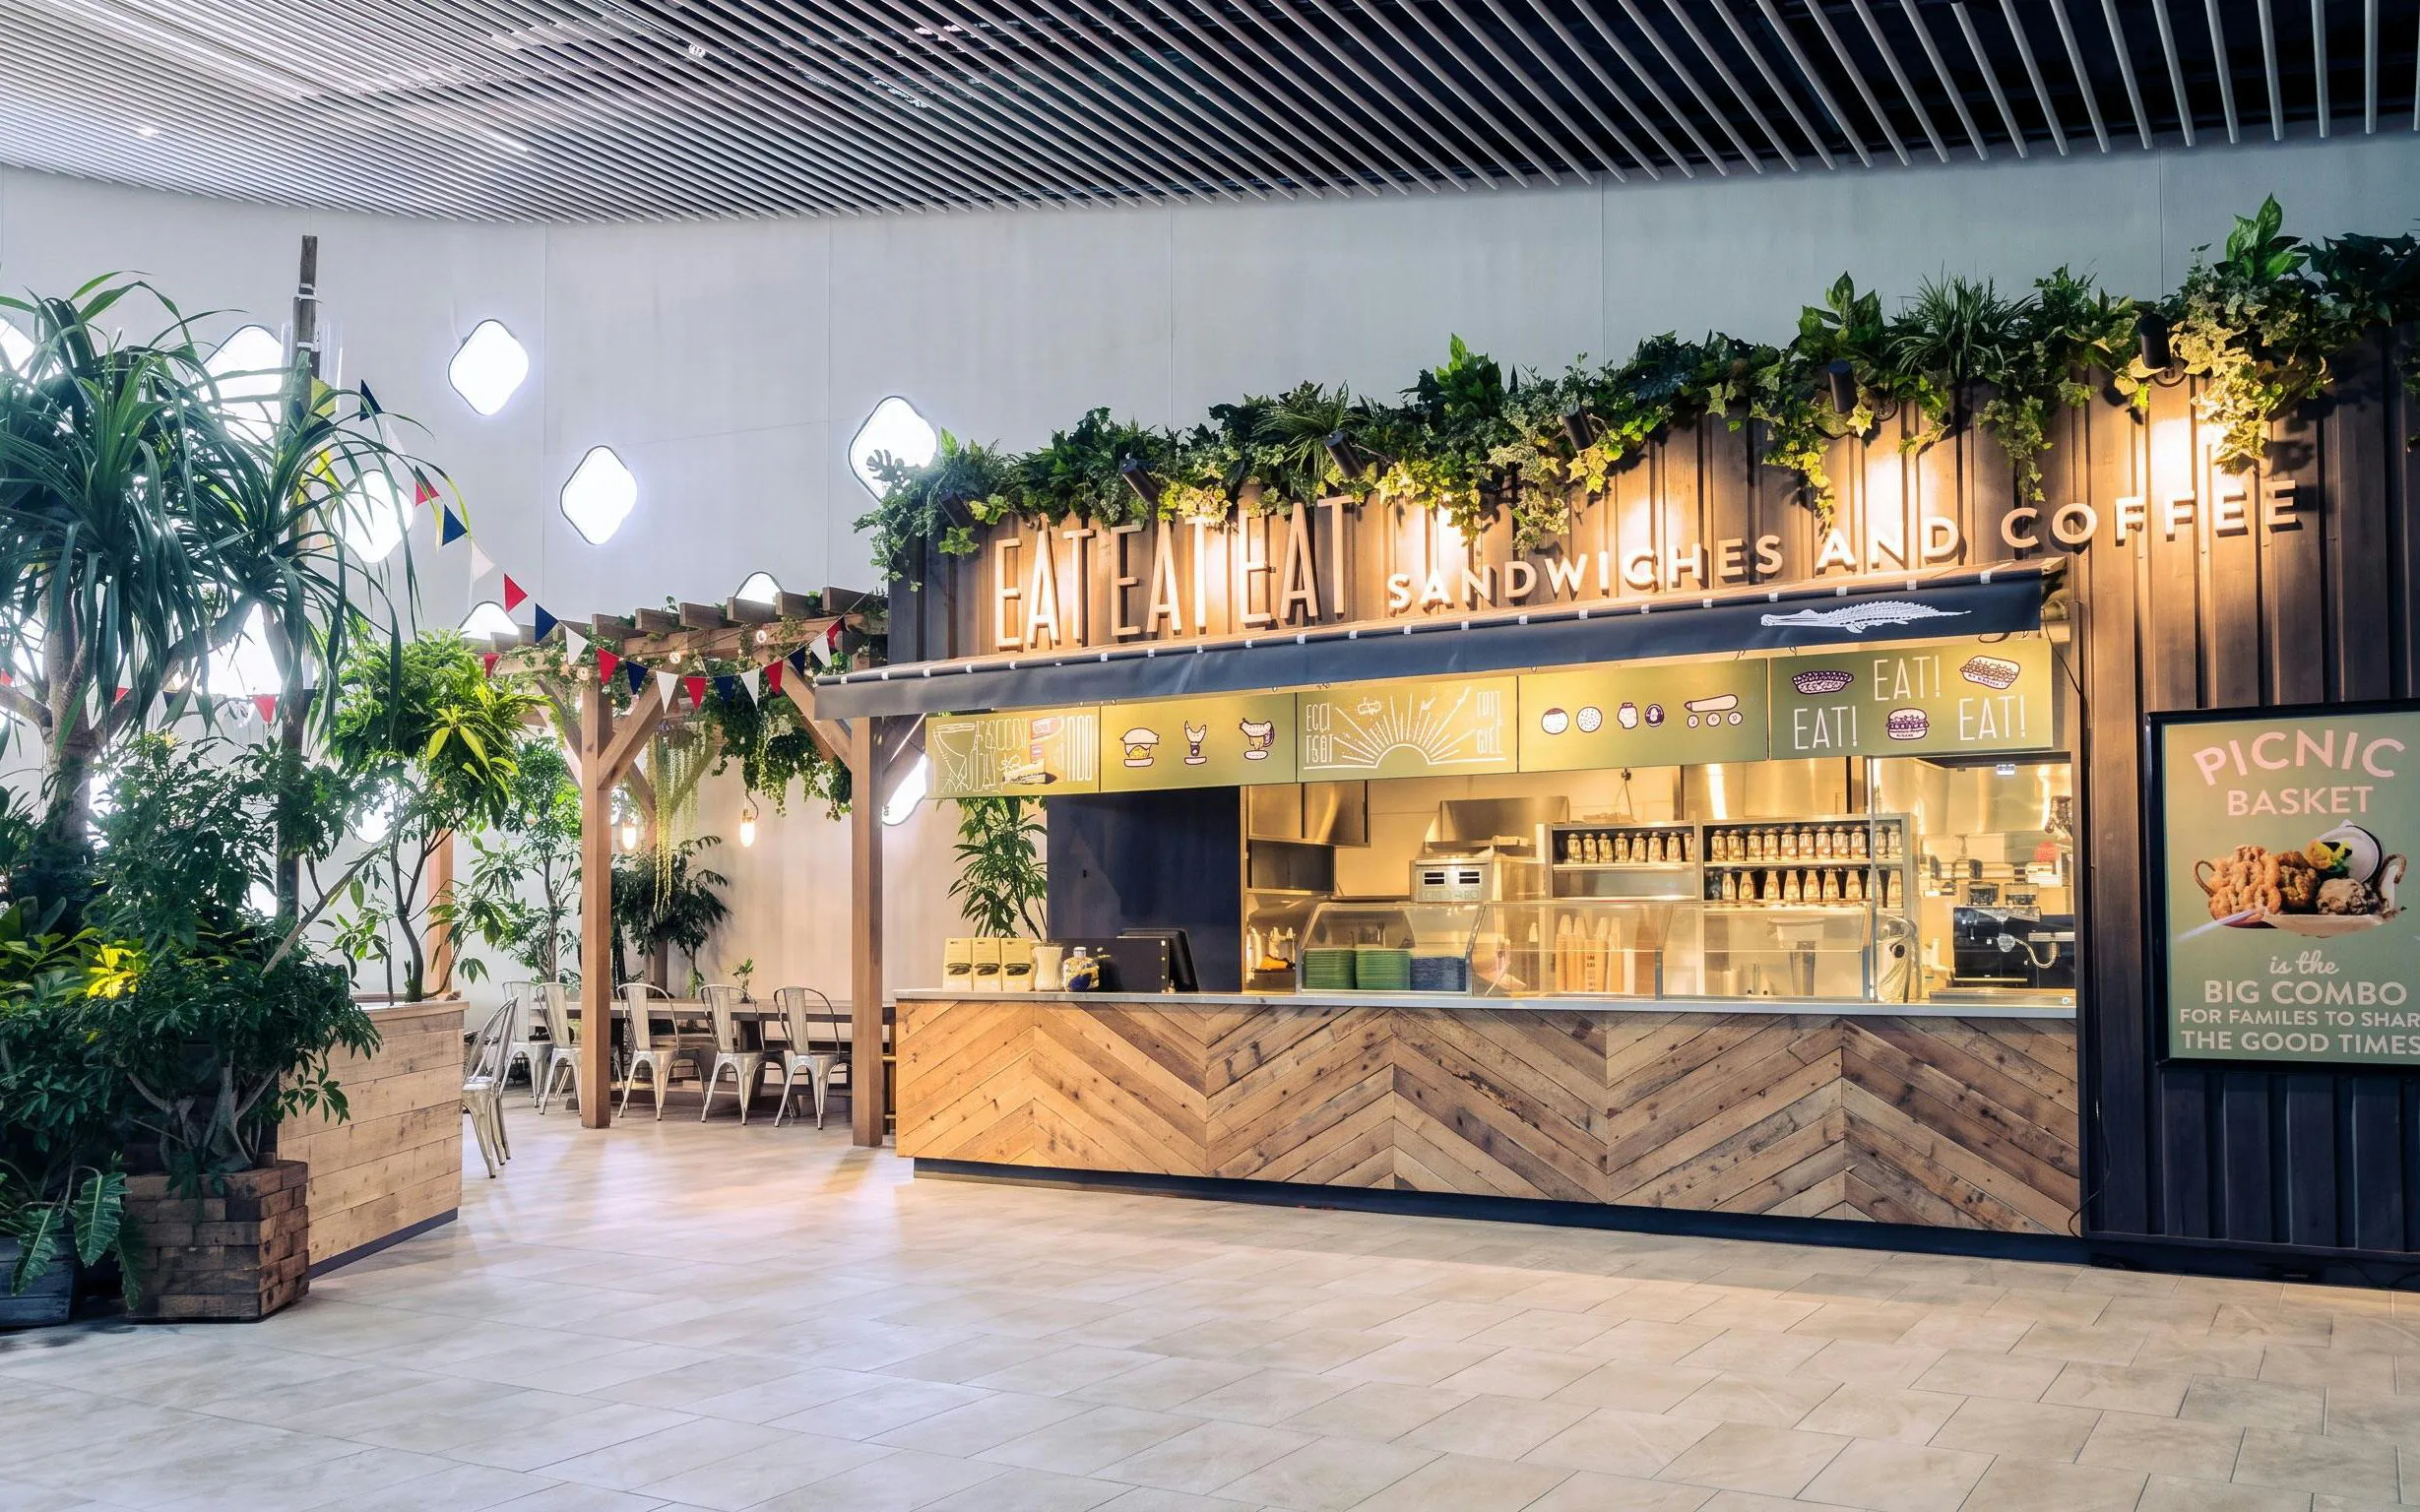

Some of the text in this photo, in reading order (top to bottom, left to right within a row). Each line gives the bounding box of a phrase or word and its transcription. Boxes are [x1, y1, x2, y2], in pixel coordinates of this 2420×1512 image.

[1386, 479, 2297, 608] SANDWICHES AND COFFEE
[995, 495, 1355, 647] EAT EAT EAT
[1873, 655, 1941, 701] EAT!
[1793, 705, 1859, 750] EAT!
[1958, 694, 2026, 741] EAT!
[2192, 728, 2406, 787] PICNIC
[2227, 786, 2374, 816] BASKET
[2268, 949, 2340, 976] is the
[2203, 979, 2407, 1006] BIG COMBO
[2180, 1008, 2420, 1028] FOR FAMILES TO SHAR
[2181, 1030, 2420, 1055] THE GOOD TIMES
